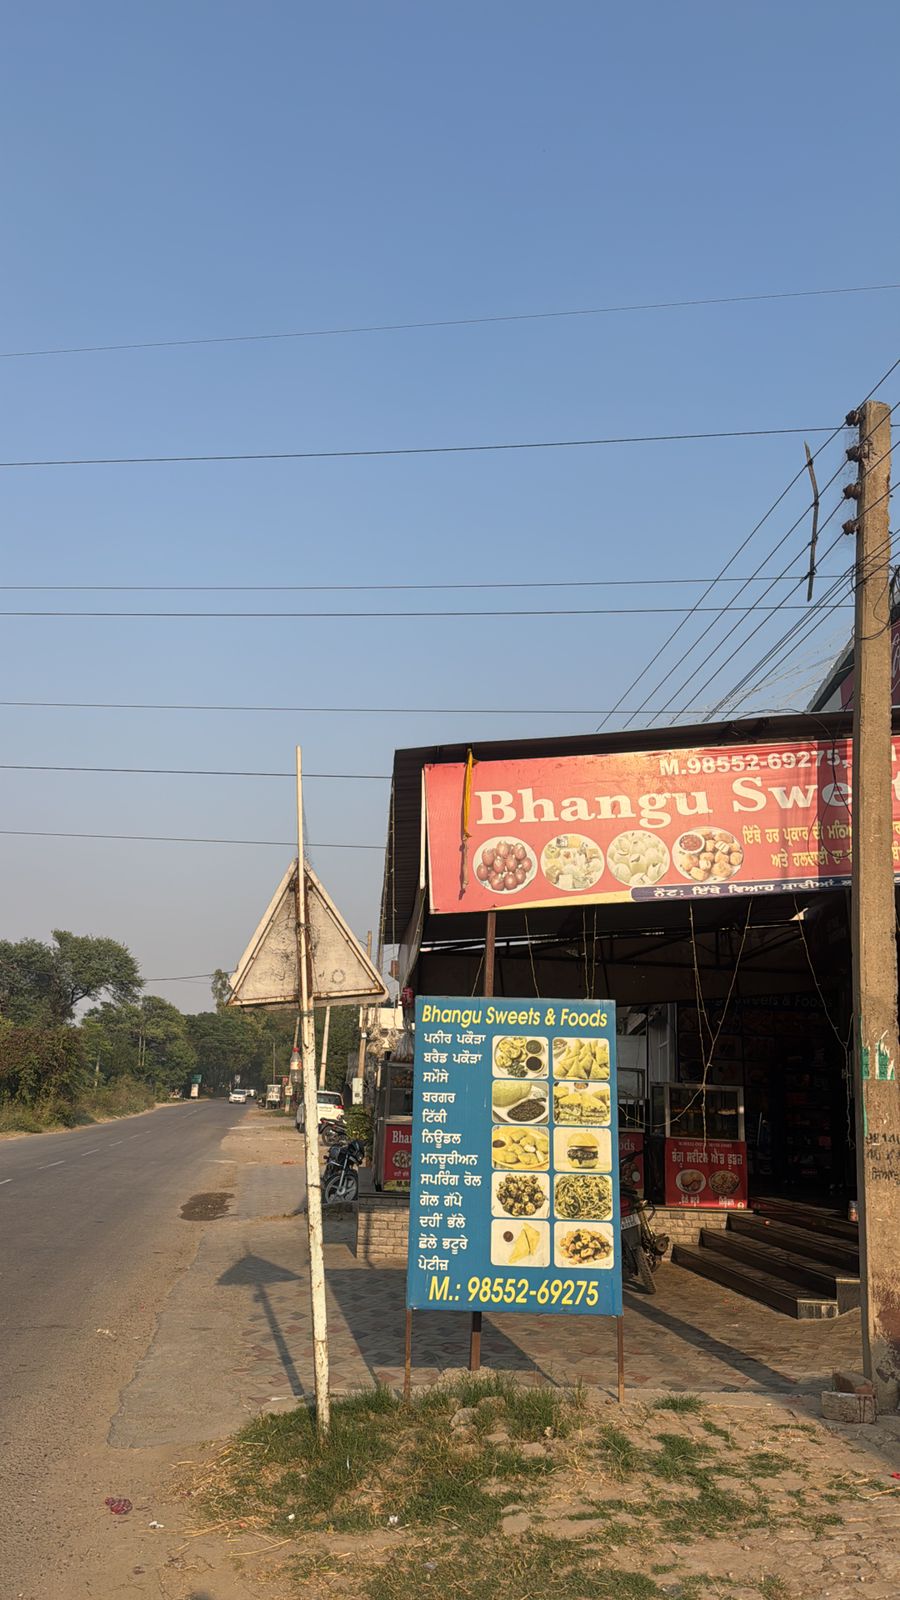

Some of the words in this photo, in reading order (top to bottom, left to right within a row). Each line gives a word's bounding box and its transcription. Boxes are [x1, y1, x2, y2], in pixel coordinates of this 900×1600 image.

[473, 787, 713, 829] Bhangu
[731, 771, 900, 812] Swe
[743, 825, 761, 845] ਇੱਥੇ
[765, 828, 779, 844] ਹਰ
[783, 826, 808, 847] ਪ੍ਰਕਾਰ
[771, 848, 788, 868] ਅਤੇ
[728, 883, 775, 894] ਵਿਆਹ
[421, 1004, 482, 1028] Bhangu
[485, 1006, 541, 1026] Sweets
[544, 1008, 556, 1026] &
[560, 1009, 607, 1027] Foods
[423, 1030, 453, 1044] ਪਨੀਰ
[456, 1030, 486, 1045] ਪਕੌੜਾ
[423, 1048, 449, 1064] ਬਰੈਡ
[452, 1049, 482, 1064] ਪਕੌੜਾ
[422, 1068, 449, 1083] ਸਮੌਸੇ
[422, 1092, 456, 1103] ਬਰਗਰ
[422, 1108, 447, 1123] ਟਿੱਕੀ
[391, 1130, 412, 1144] Bha
[421, 1128, 462, 1149] ਨਿਊਡਲ
[420, 1150, 478, 1169] ਮਨਚੂਰੀਅਨ
[420, 1170, 459, 1186] ਸਪਰਿੰਗ
[463, 1171, 482, 1187] ਰੋਲ
[419, 1190, 440, 1206] ਗੋਲ
[443, 1191, 463, 1207] ਗੱਪੇ
[419, 1212, 443, 1228] ਦਹੀਂ
[447, 1213, 466, 1229] ਭੱਲੇ
[418, 1233, 438, 1249] ਛੋਲੇ
[442, 1234, 468, 1255] ਭਟੂਰੇ
[428, 1276, 461, 1301] M.:
[467, 1276, 599, 1306] 98552-69275
